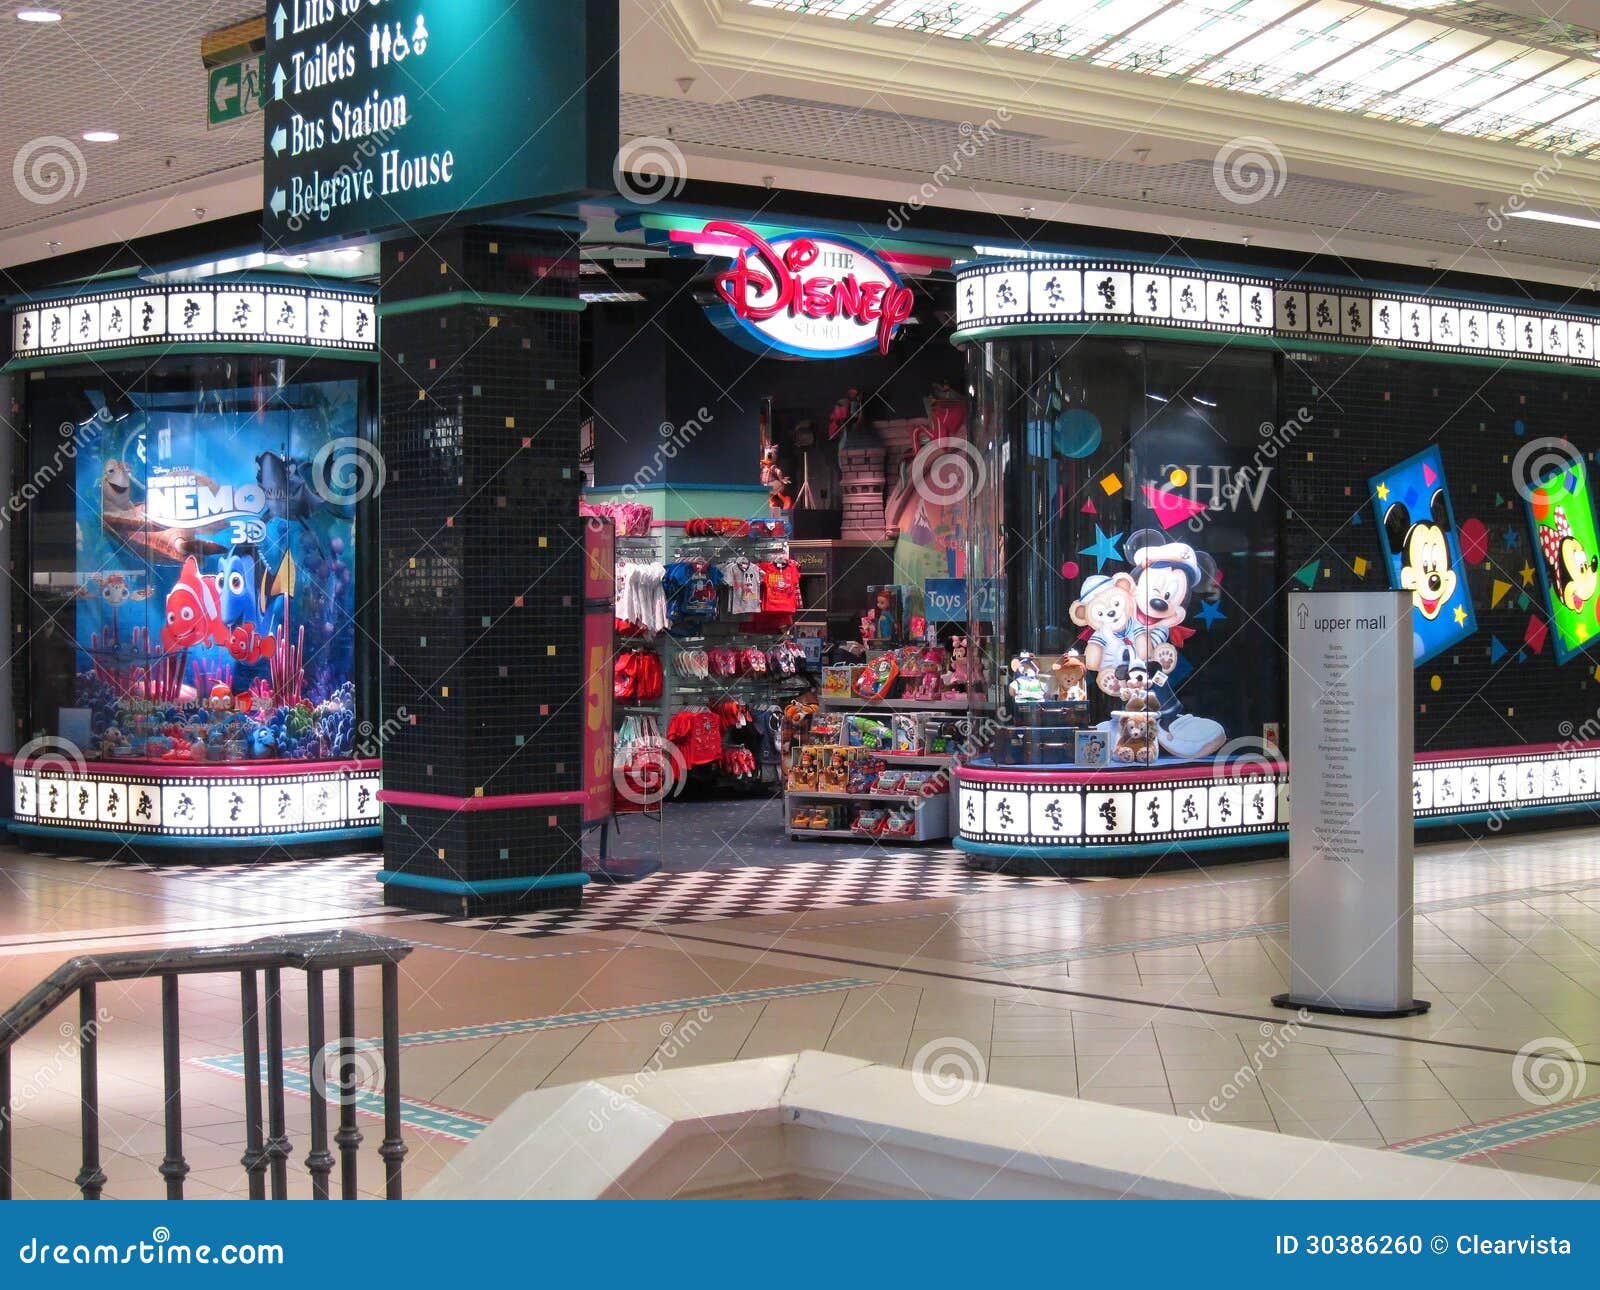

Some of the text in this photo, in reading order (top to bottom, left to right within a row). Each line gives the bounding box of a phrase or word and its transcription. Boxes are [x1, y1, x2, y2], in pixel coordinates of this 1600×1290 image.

[292, 0, 335, 34] Lifts
[291, 41, 355, 95] Toilets
[291, 89, 407, 157] Bus Station
[291, 150, 454, 221] Belgrave House
[823, 251, 854, 269] THE
[147, 484, 266, 519] NEMO
[230, 519, 266, 544] 3D
[928, 591, 961, 611] Toys
[1314, 616, 1386, 632] upper mall
